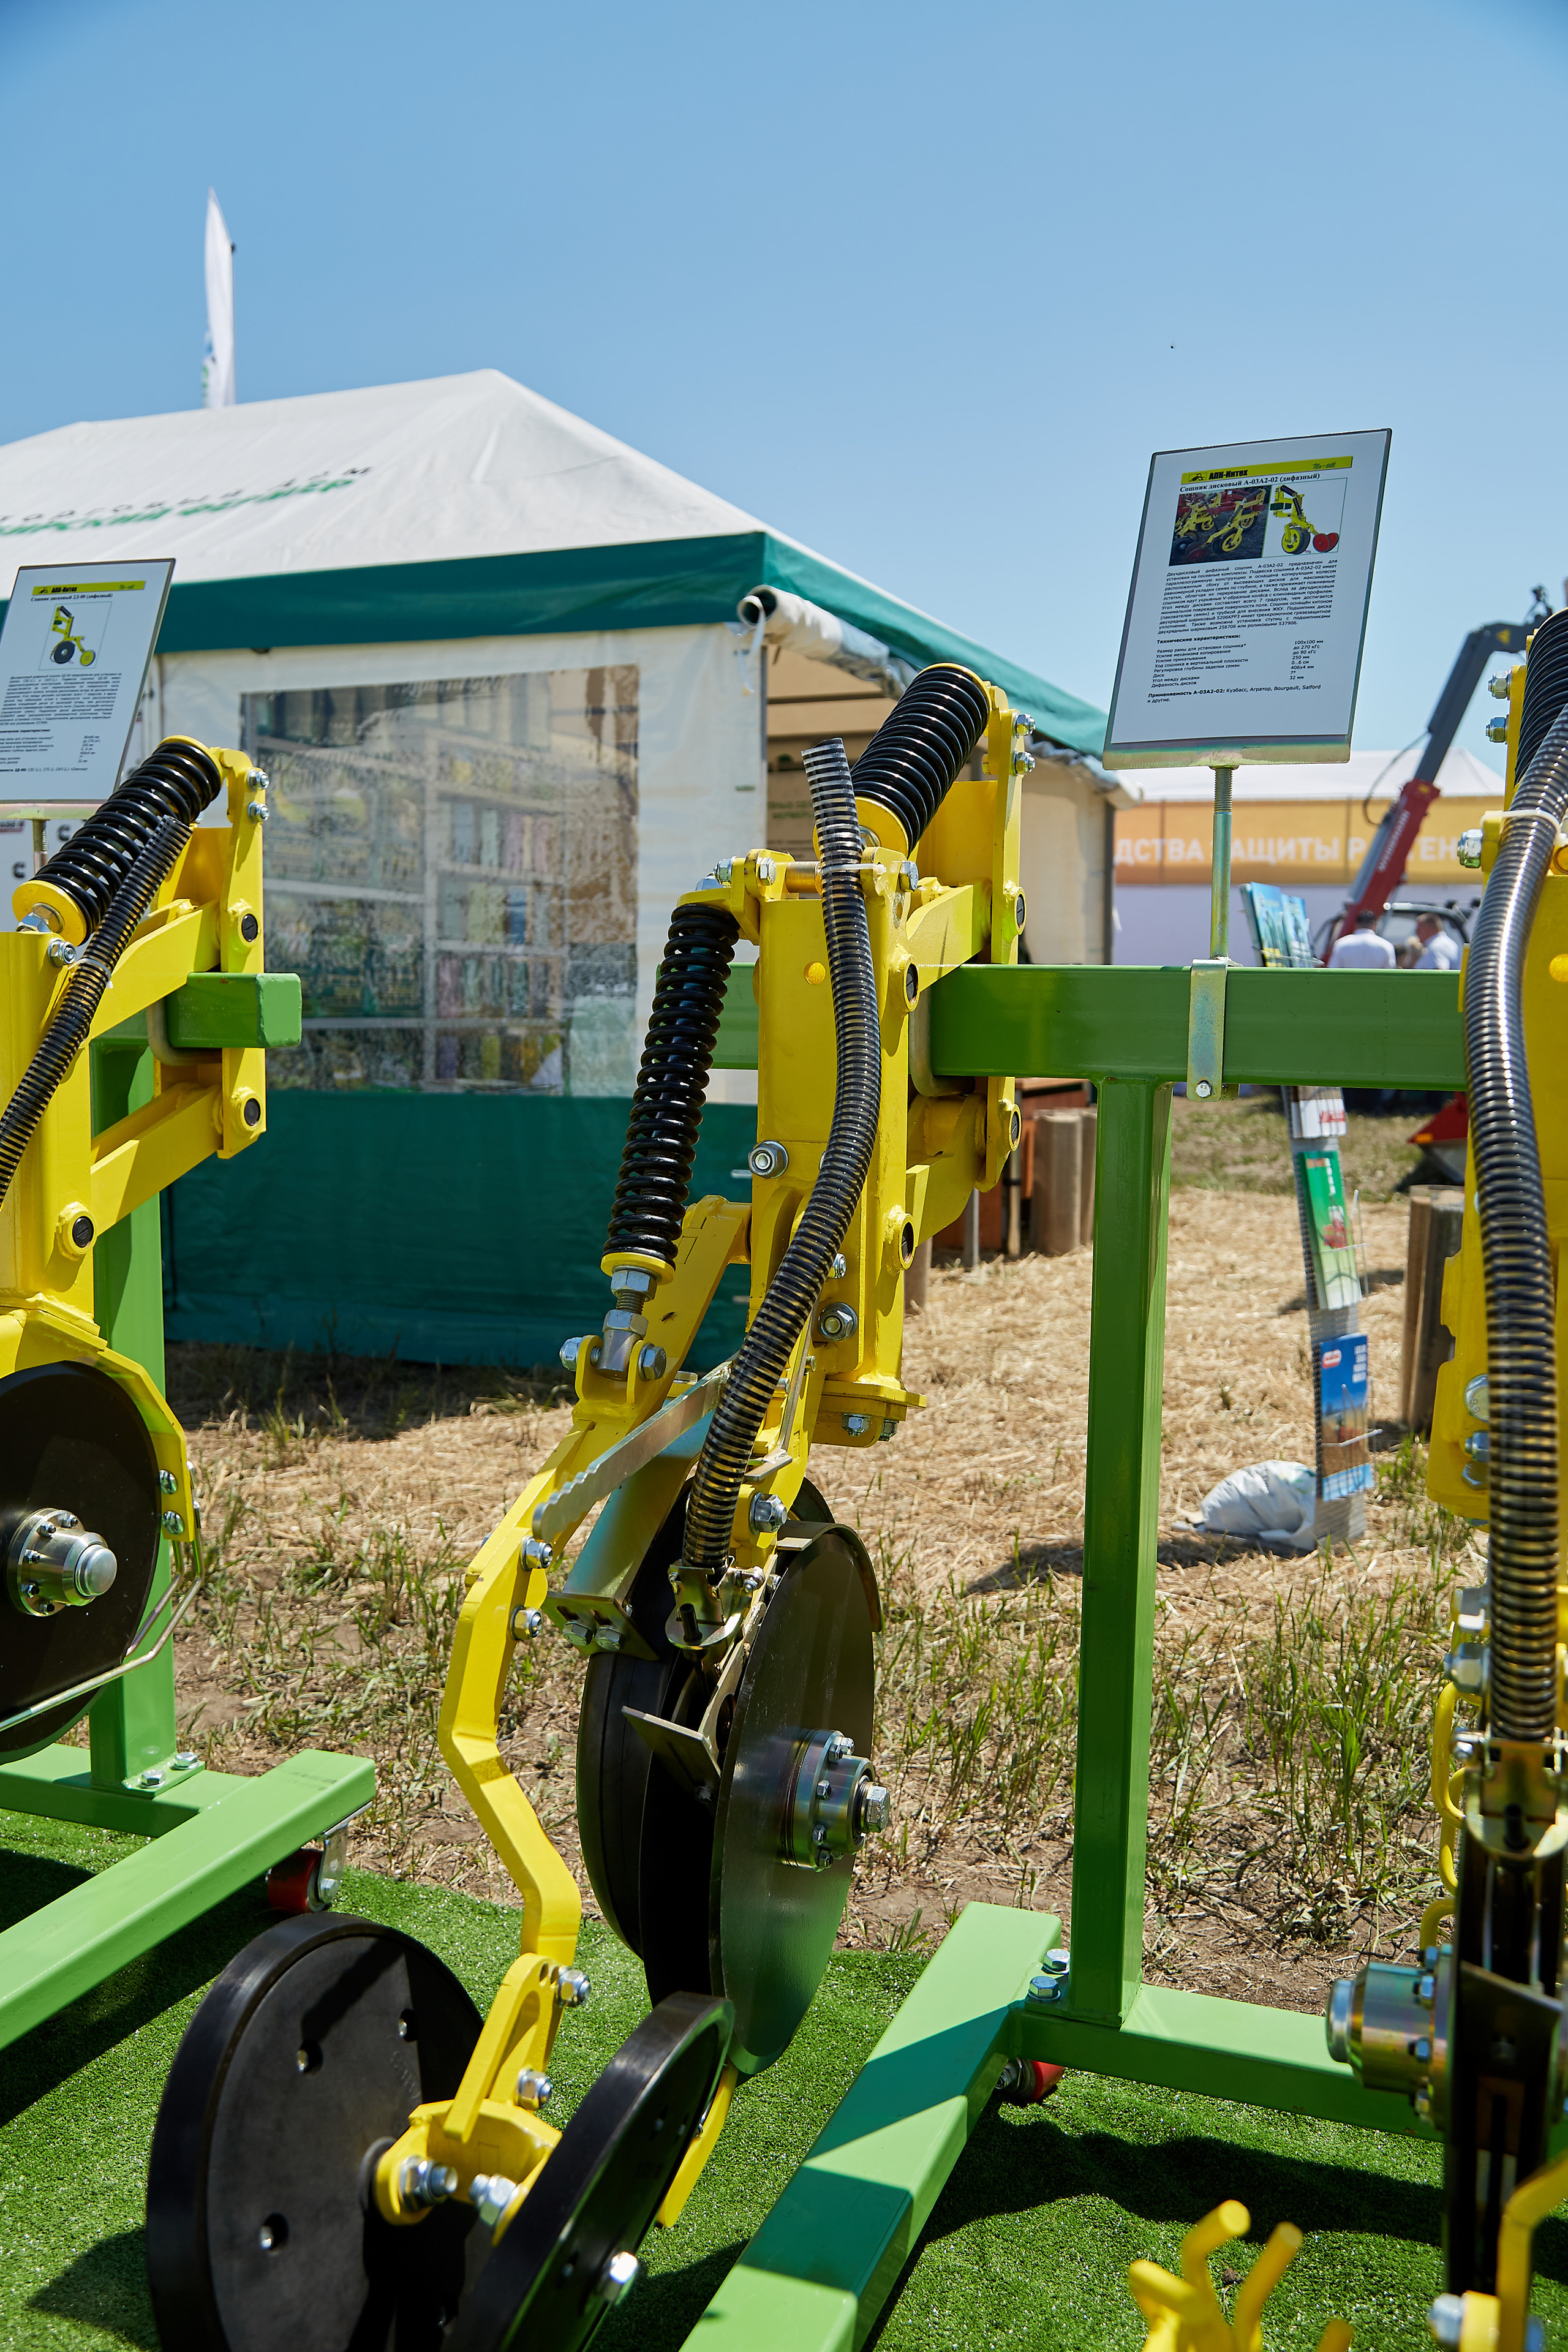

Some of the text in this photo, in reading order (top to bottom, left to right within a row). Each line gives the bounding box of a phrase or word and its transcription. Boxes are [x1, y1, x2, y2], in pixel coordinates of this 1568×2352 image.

[1209, 469, 1248, 480] АПК-Интех
[1280, 473, 1320, 483] (дифазный)
[1211, 837, 1338, 865] АЩИТЫ
